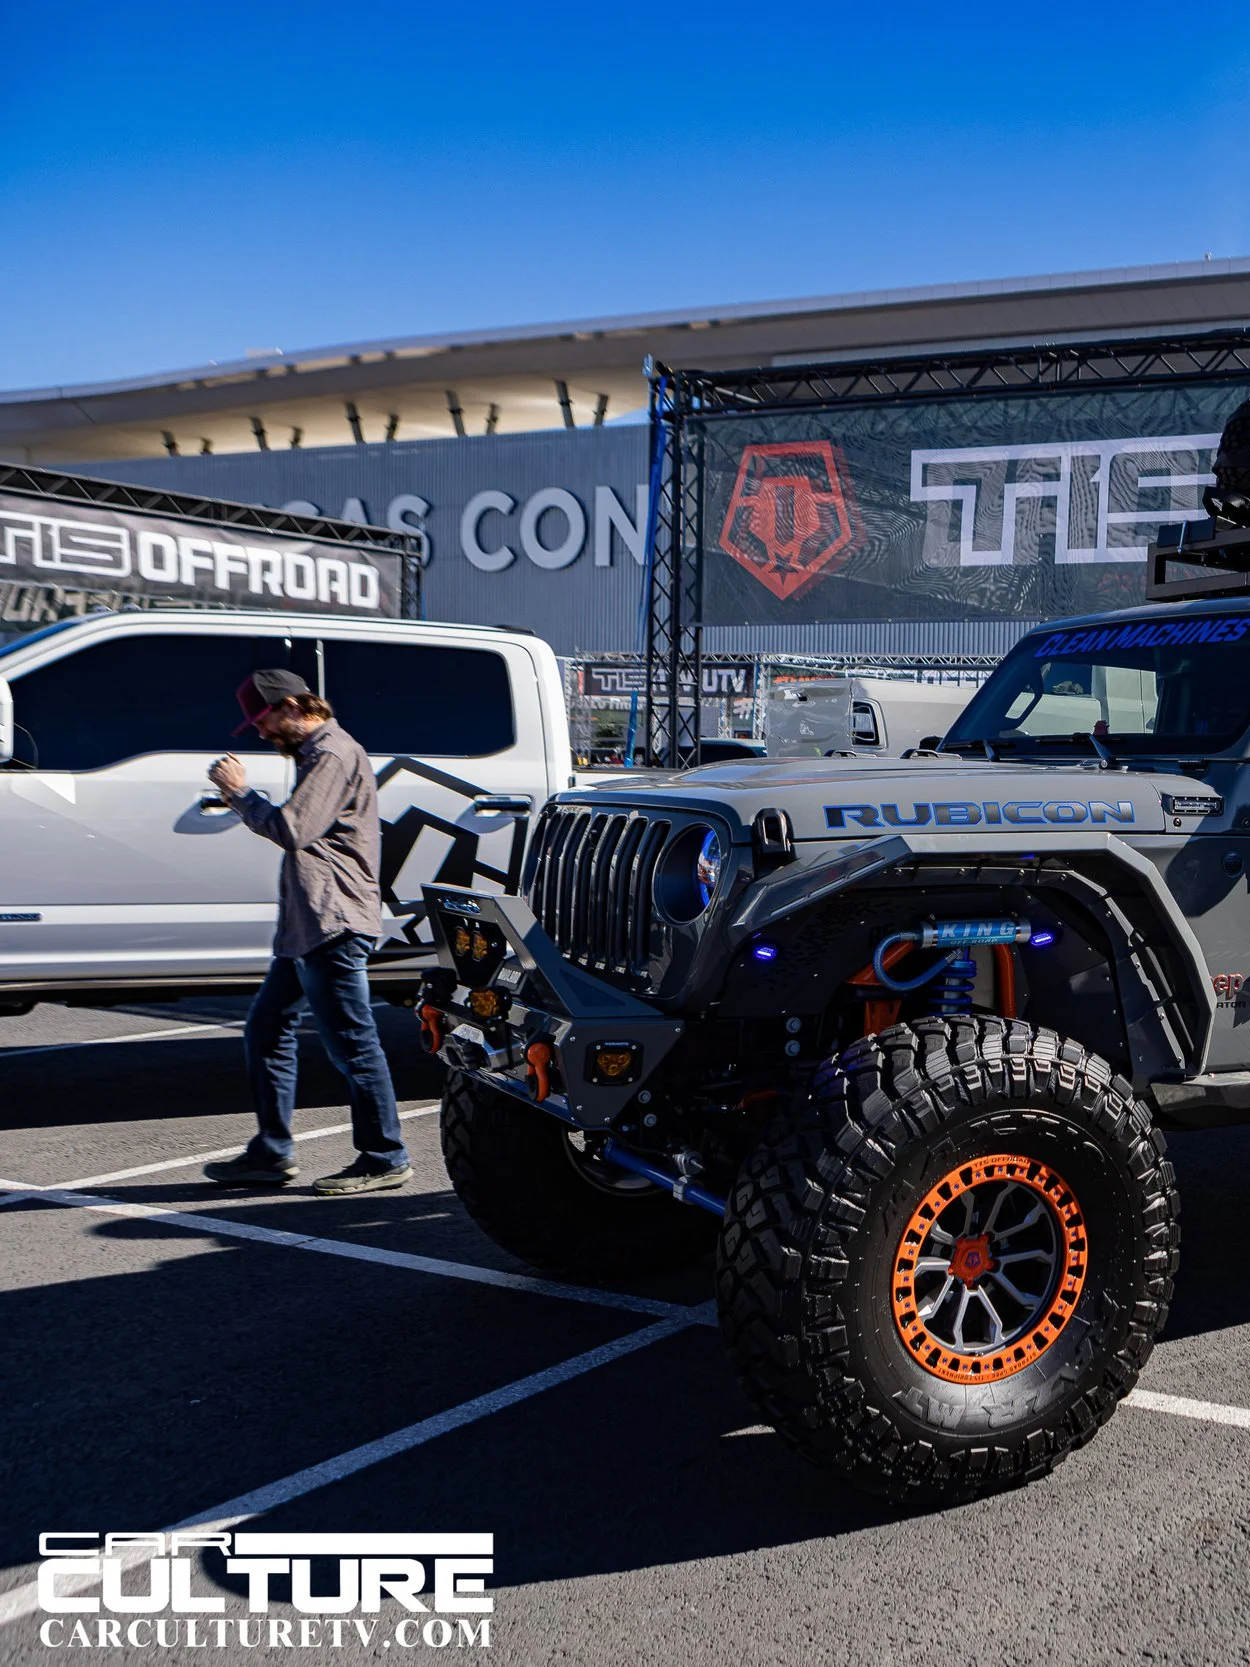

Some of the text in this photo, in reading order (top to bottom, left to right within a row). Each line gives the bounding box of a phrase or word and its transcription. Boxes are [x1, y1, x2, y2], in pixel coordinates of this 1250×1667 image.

[136, 530, 380, 609] OFFROAD
[1035, 624, 1118, 658] CLEAN
[703, 669, 746, 693] UTV
[824, 800, 1135, 829] RUBICON
[941, 921, 1016, 938] KING
[1210, 973, 1244, 1000] ep
[991, 1156, 1029, 1164] OFFROAD
